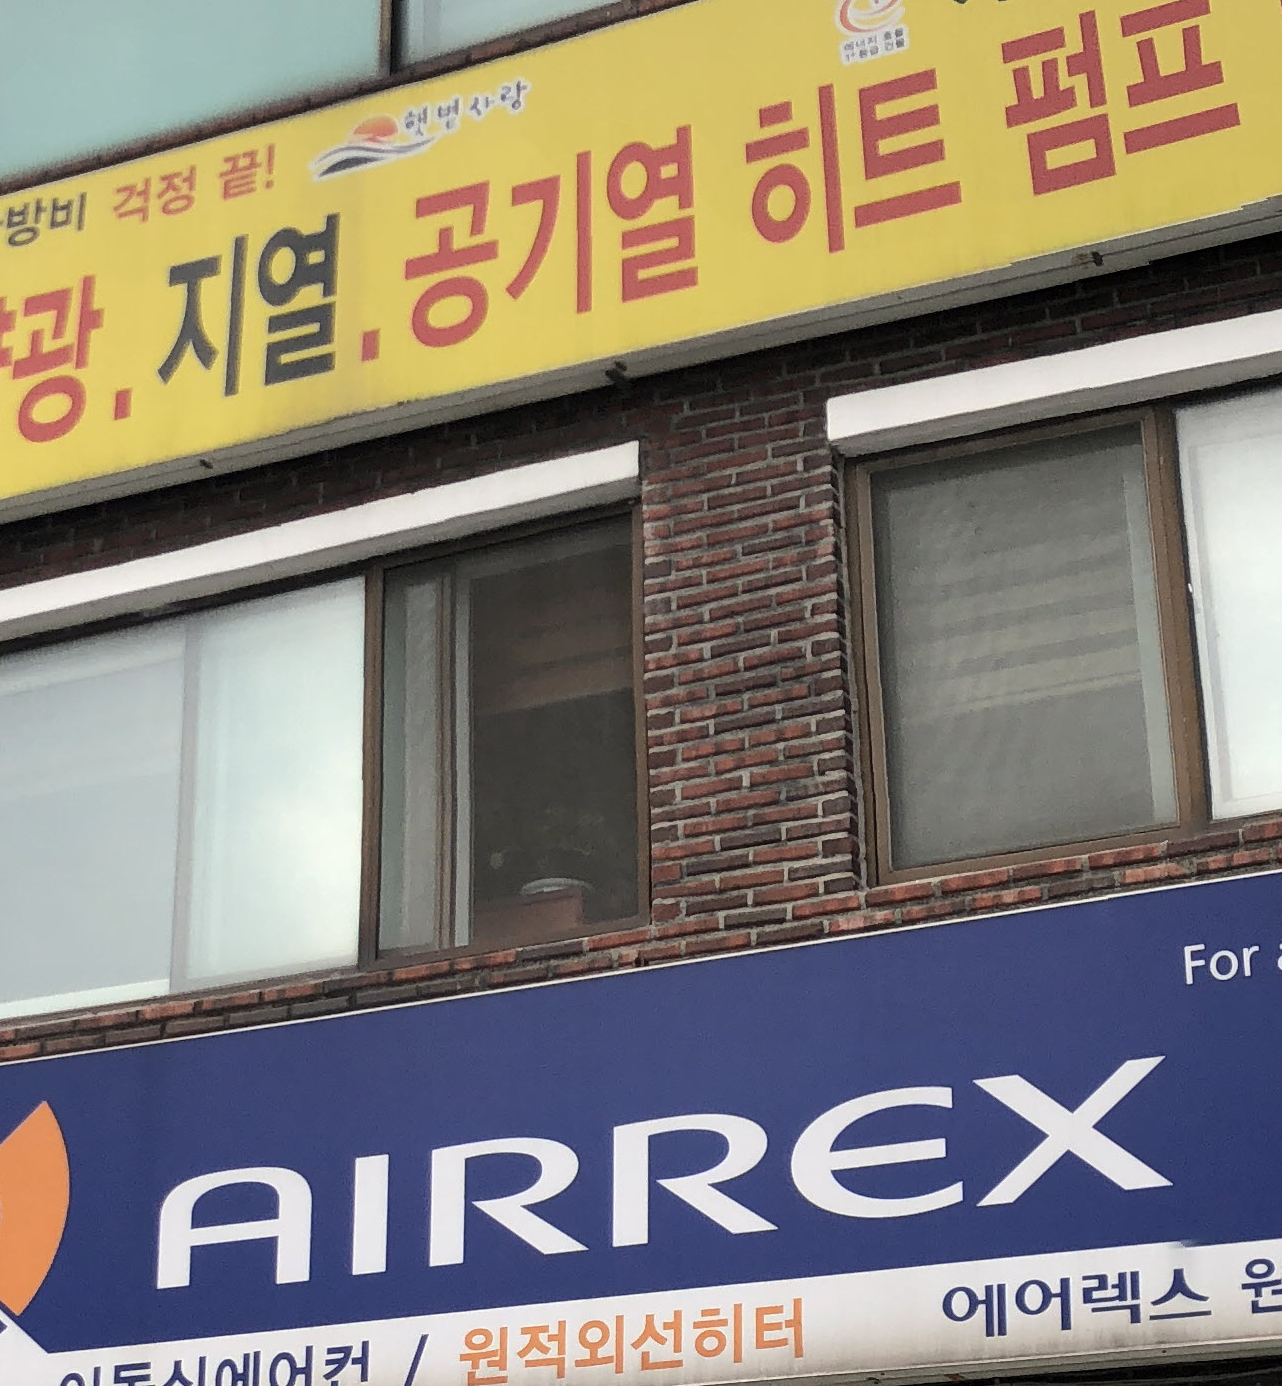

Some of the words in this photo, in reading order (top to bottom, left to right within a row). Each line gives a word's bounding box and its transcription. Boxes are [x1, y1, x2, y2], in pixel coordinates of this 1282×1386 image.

[112, 165, 197, 223] 걱정
[217, 144, 277, 201] 끝!
[1182, 941, 1261, 986] For
[156, 1054, 1174, 1291] AIRREX
[941, 1262, 1211, 1339] 에어렉스
